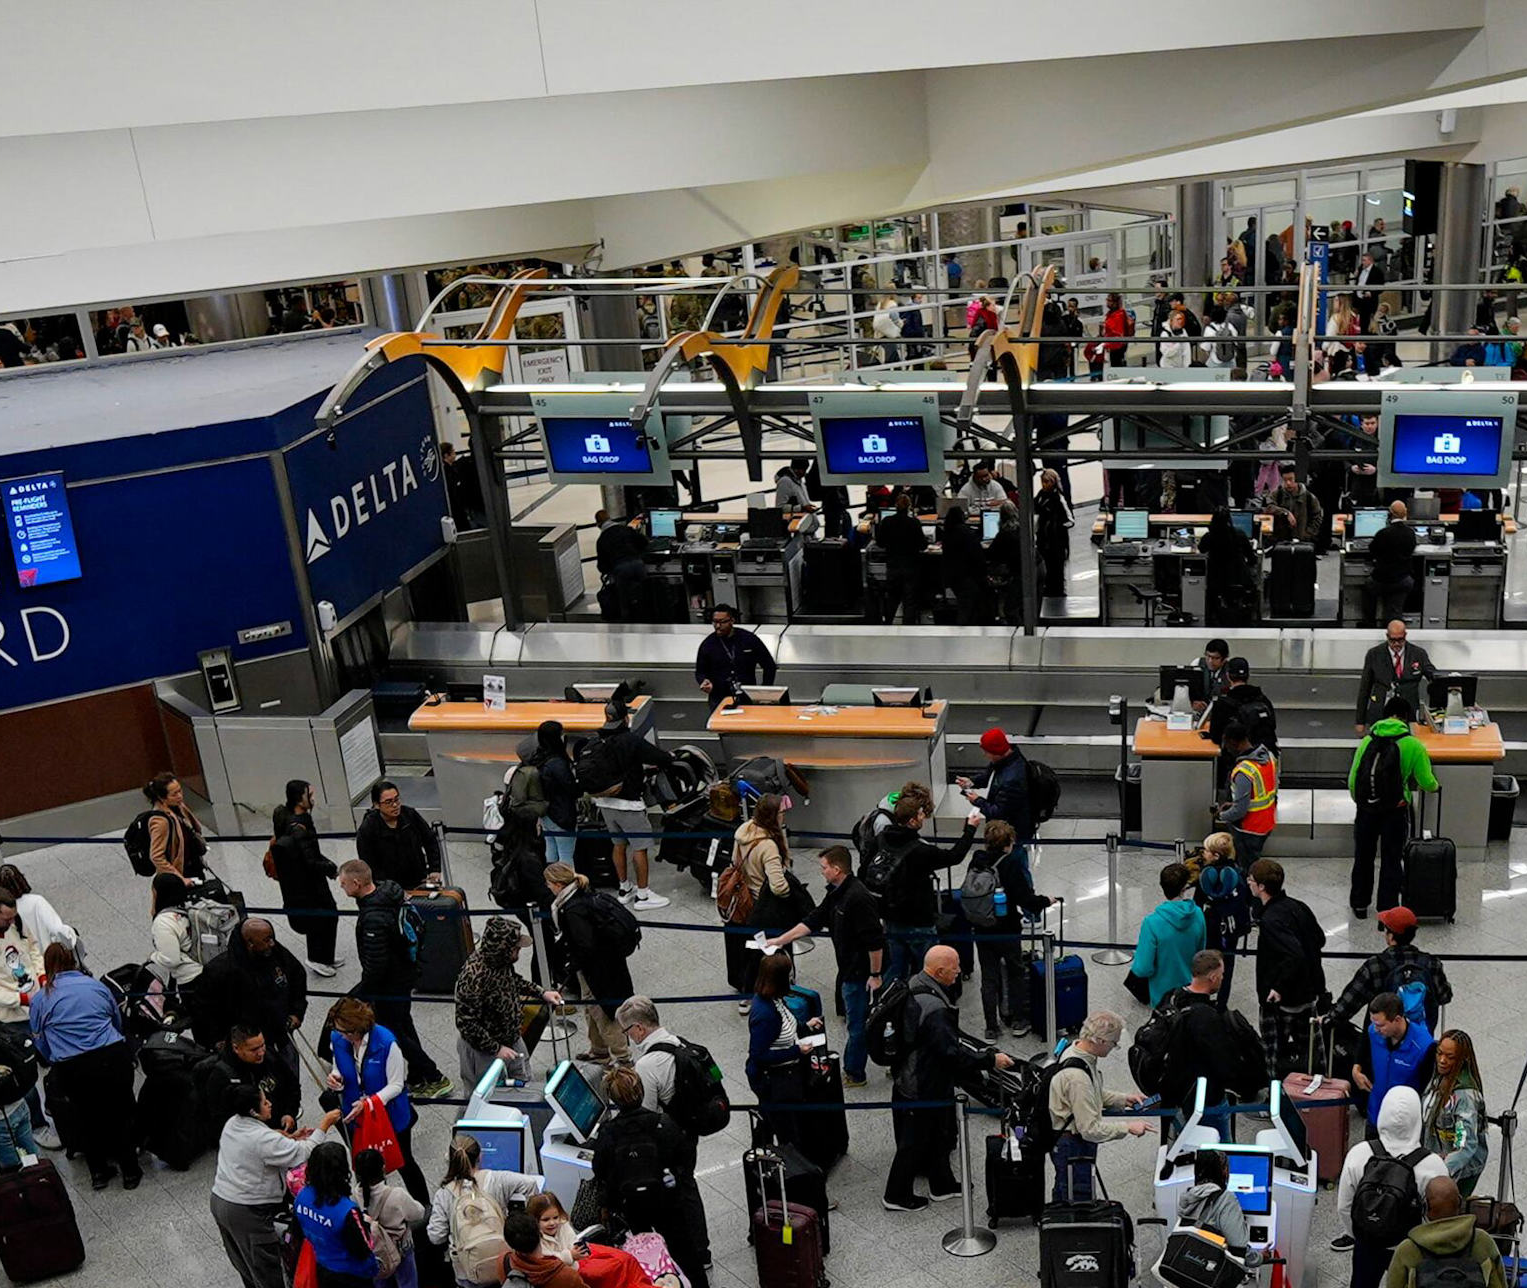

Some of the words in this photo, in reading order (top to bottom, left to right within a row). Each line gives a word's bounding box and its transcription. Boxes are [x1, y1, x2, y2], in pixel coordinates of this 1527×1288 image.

[523, 354, 564, 368] EMERGENCY
[537, 367, 552, 375] EXIT
[537, 376, 555, 384] ONLY
[535, 399, 547, 407] 45
[1386, 395, 1399, 403] 49
[1502, 396, 1515, 404] 50
[1426, 456, 1443, 464] BAG
[1444, 456, 1467, 464] DROP
[18, 482, 48, 493] DELTA
[330, 454, 418, 539] DELTA
[303, 1205, 332, 1228] DELTA
